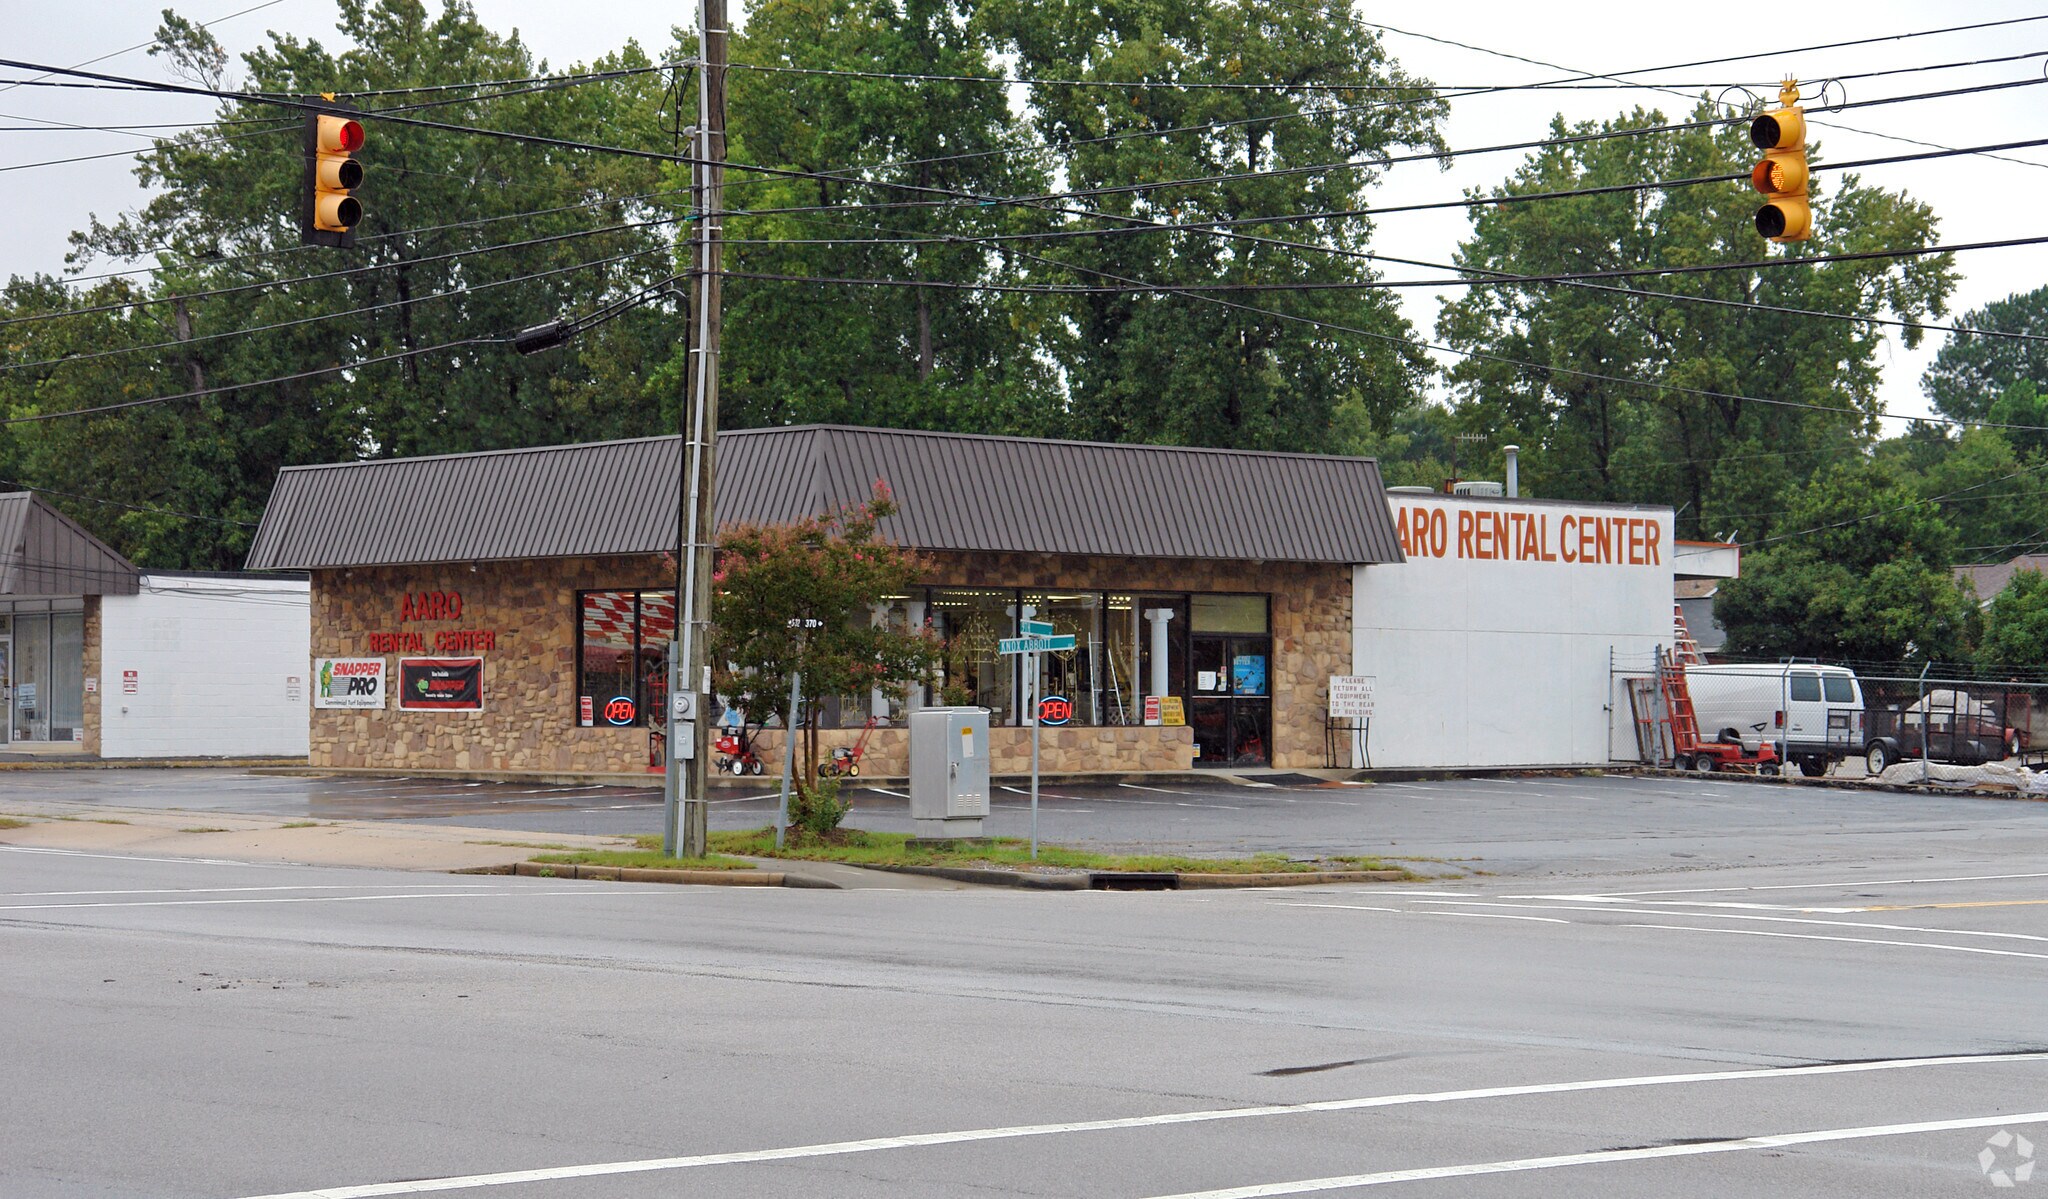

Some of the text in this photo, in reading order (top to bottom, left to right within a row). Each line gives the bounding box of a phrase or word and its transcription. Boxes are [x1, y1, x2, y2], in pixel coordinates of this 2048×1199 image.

[1458, 510, 1557, 562] RENTAL
[1560, 514, 1661, 566] CENTER
[400, 591, 463, 621] AARO
[805, 618, 817, 628] 370
[369, 630, 495, 652] RENTAL CENTER
[1001, 638, 1051, 651] KNOX ABBOTT
[333, 662, 381, 676] SNAPPER
[347, 677, 377, 695] PRO
[604, 701, 636, 720] OPEN
[1038, 701, 1073, 720] OPEN
